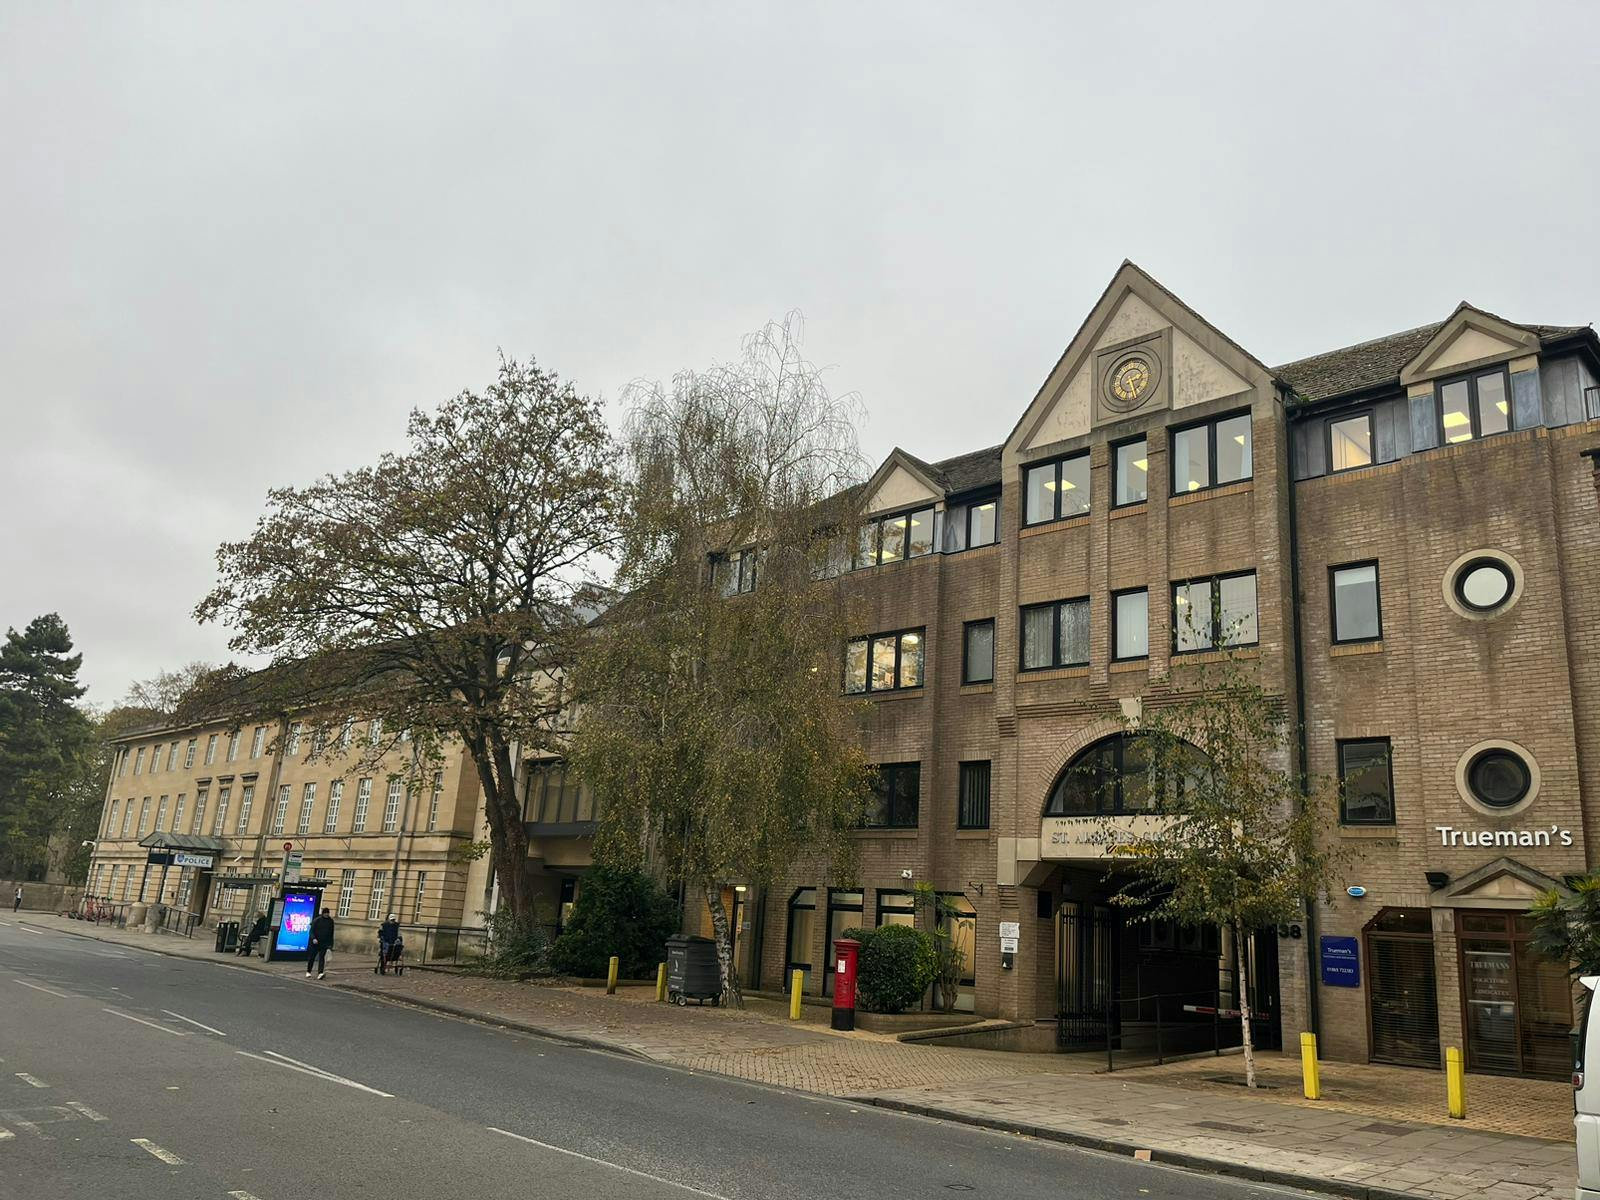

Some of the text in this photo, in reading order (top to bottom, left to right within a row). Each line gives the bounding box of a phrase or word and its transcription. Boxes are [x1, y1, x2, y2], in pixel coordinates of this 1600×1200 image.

[1051, 831, 1070, 844] ST.
[1435, 824, 1573, 846] Trueman's
[184, 857, 210, 865] POLICE
